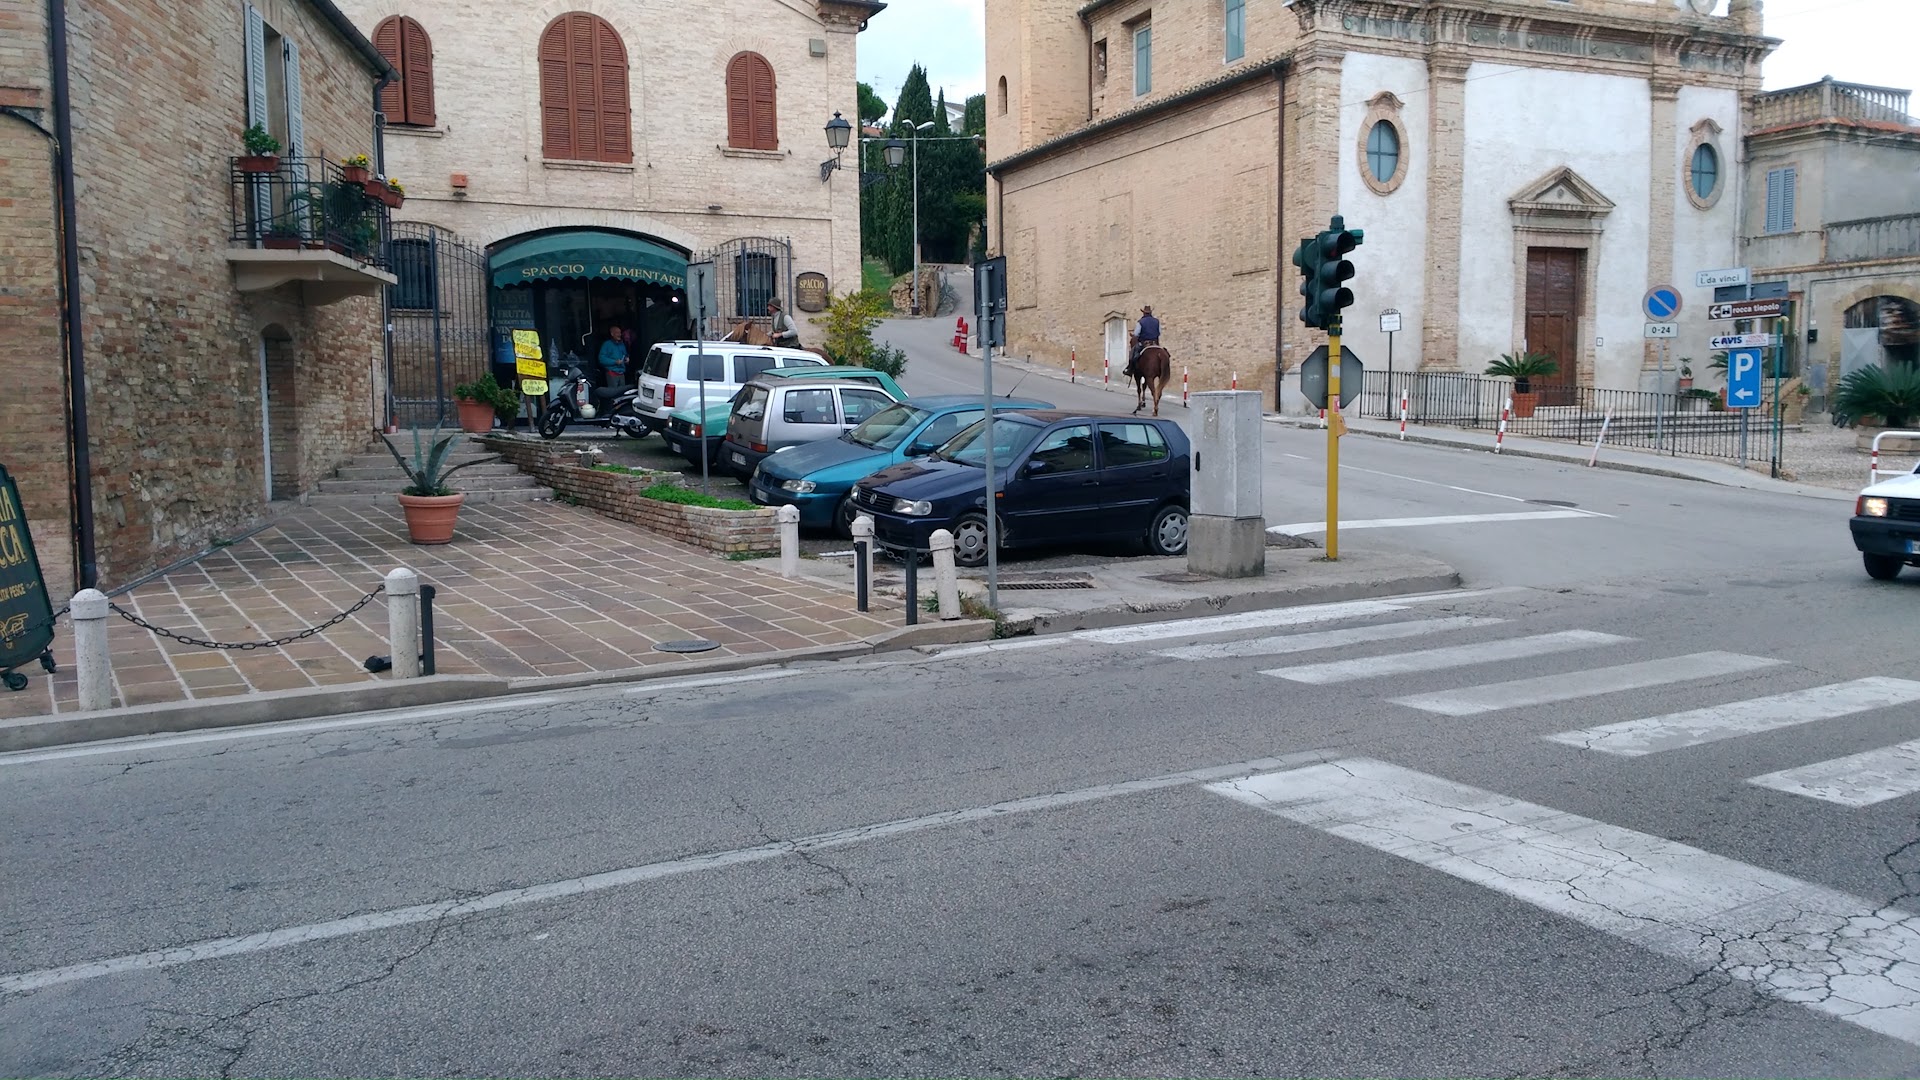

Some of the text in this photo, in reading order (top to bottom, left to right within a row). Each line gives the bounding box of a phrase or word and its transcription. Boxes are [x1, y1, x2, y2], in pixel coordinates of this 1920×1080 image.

[521, 264, 685, 287] SPACCIO ALIMENTARE
[799, 278, 825, 289] SPACCIO
[497, 309, 531, 319] FRUTTA
[1732, 303, 1780, 315] rocca tiepolo
[1651, 326, 1671, 334] 0-24
[1721, 336, 1742, 345] AVIS
[1735, 353, 1754, 382] P
